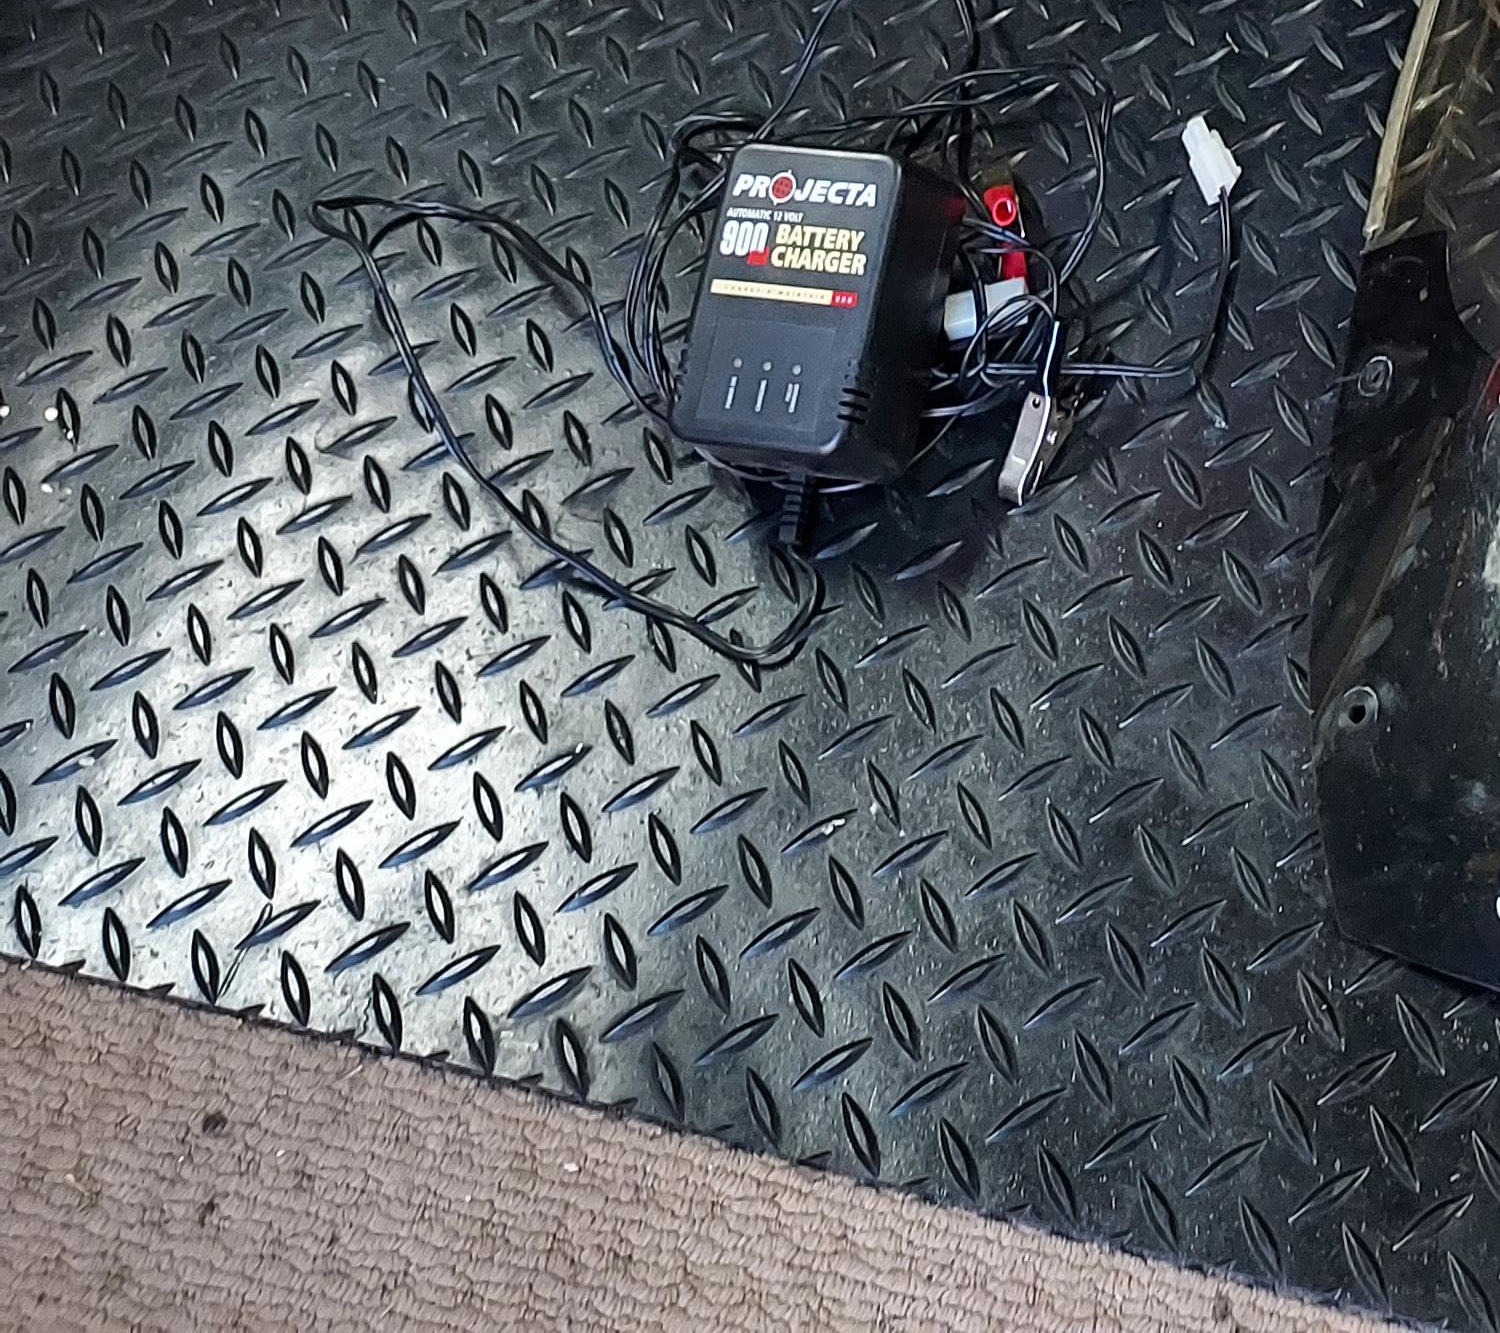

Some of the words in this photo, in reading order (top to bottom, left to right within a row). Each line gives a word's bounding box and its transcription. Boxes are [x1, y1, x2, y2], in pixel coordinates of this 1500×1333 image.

[732, 169, 878, 208] PROJECTA
[726, 207, 772, 220] AUTOMATIC
[720, 220, 769, 256] 900
[775, 223, 865, 252] BATTERY
[771, 246, 867, 276] CHARGER
